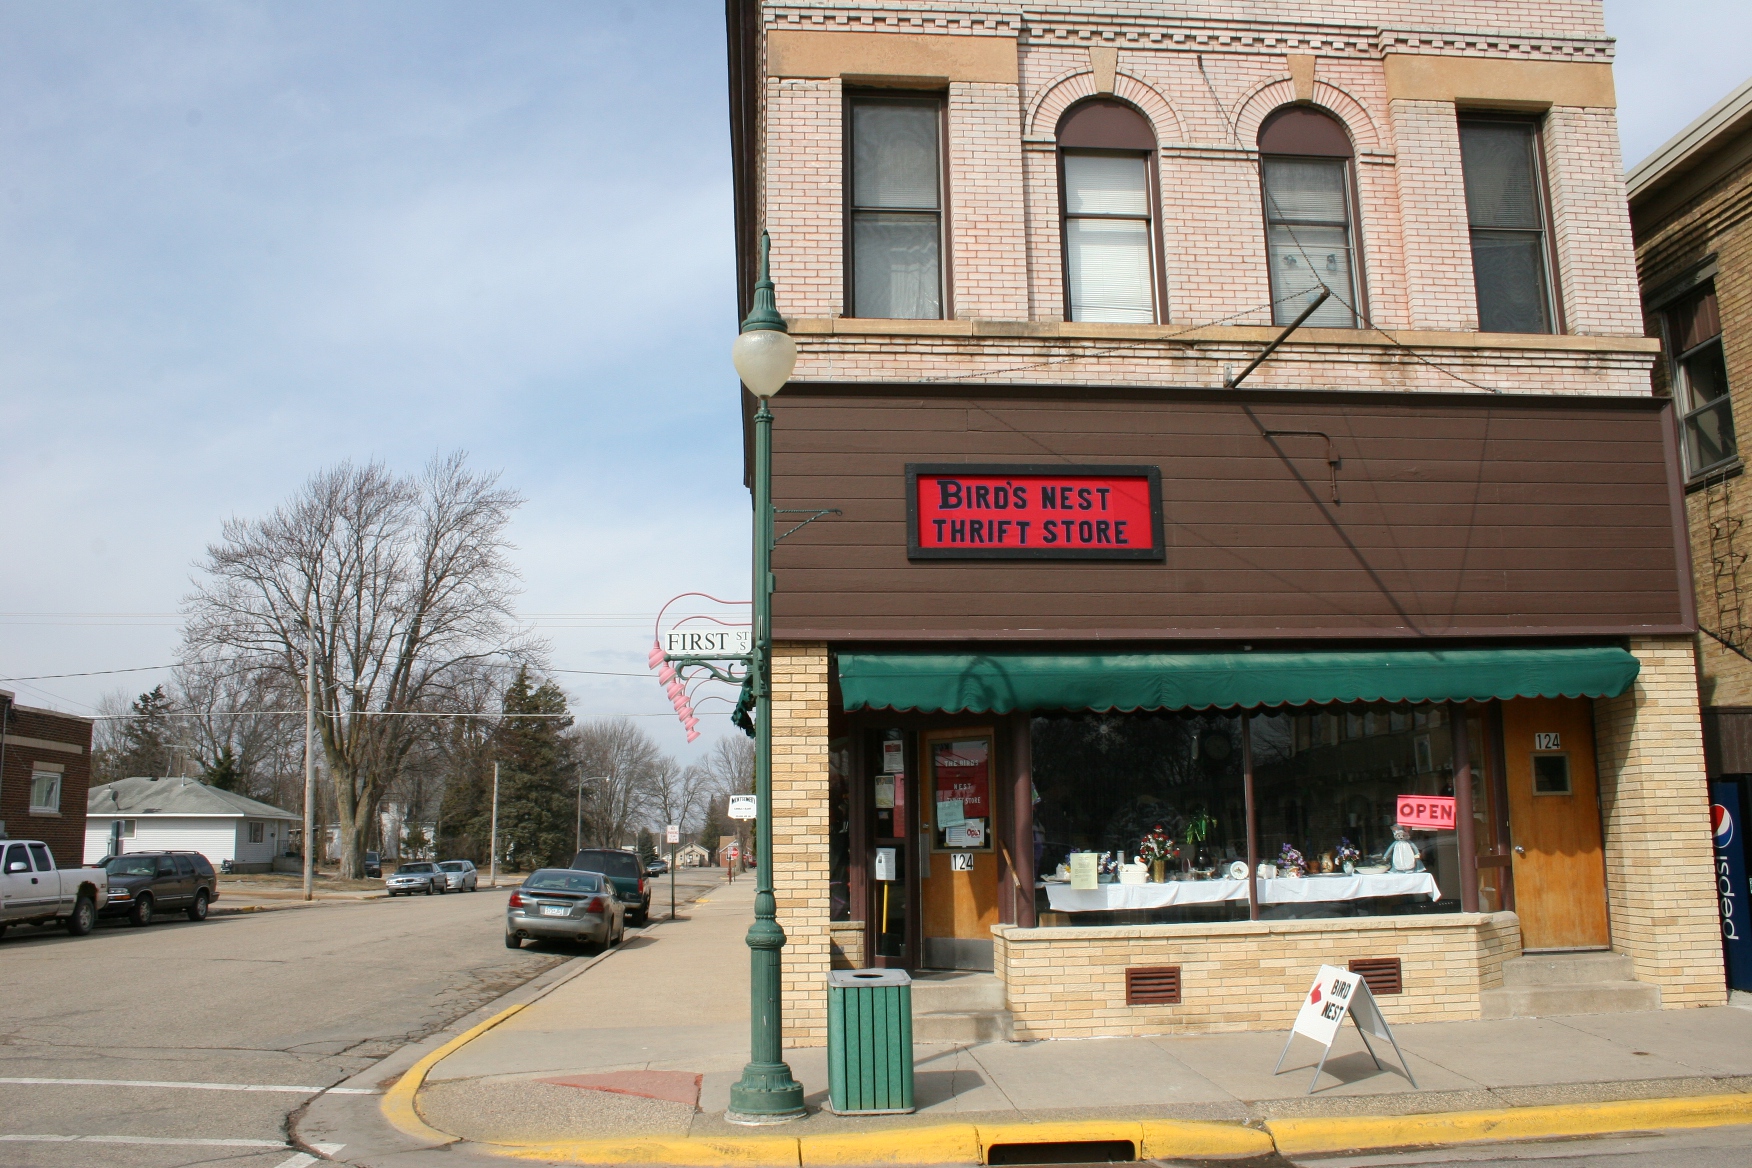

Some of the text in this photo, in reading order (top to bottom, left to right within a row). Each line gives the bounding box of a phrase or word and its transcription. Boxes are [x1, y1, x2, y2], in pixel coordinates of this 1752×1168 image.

[936, 479, 1111, 511] BIRD'S NEST
[932, 519, 1129, 545] THRIFT STORE
[667, 631, 750, 651] FIRST ST
[740, 642, 746, 651] S
[1537, 733, 1560, 749] 124
[965, 796, 981, 804] STORE
[1400, 803, 1453, 820] OPEN
[953, 854, 973, 870] 124
[1715, 855, 1740, 940] pepsi
[1330, 979, 1352, 999] BIRD
[1320, 1001, 1344, 1022] NEST
